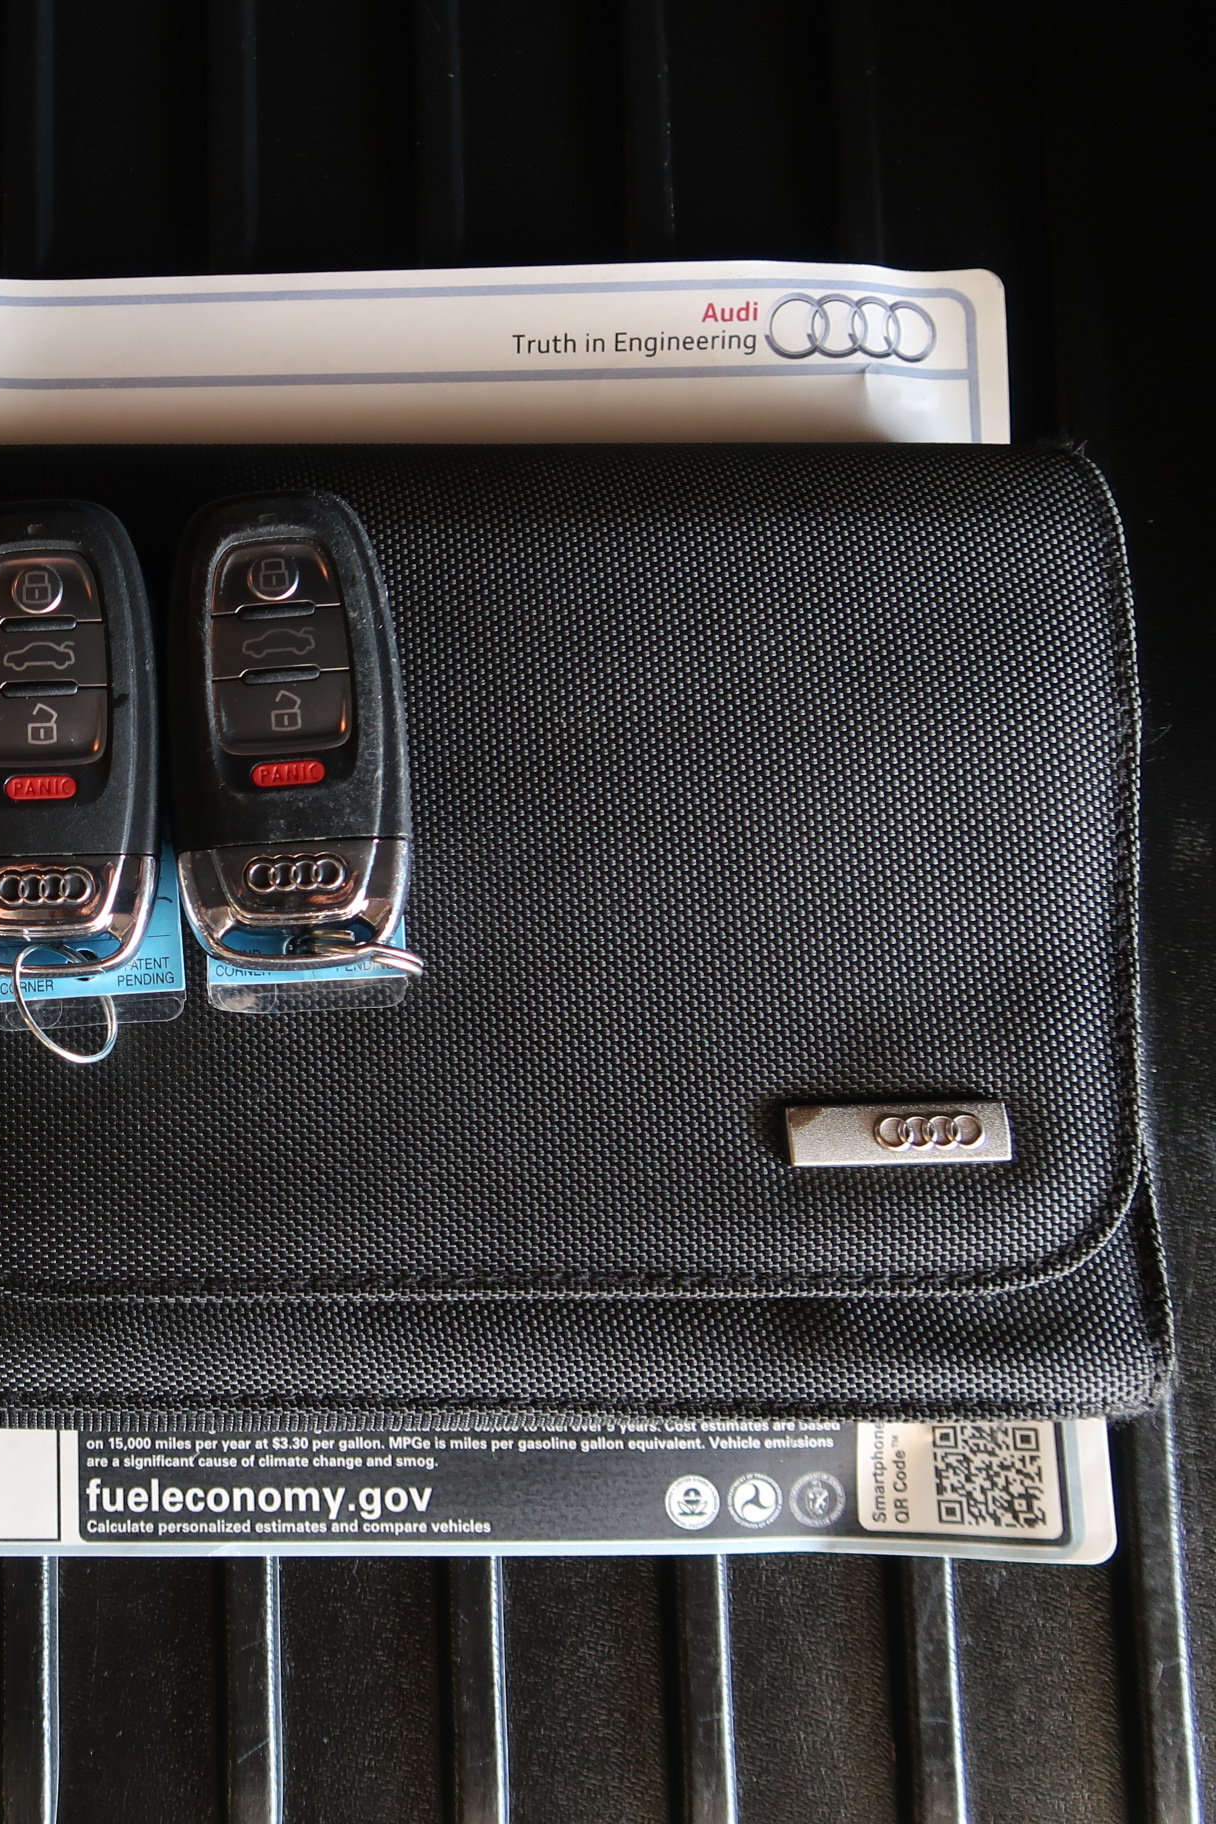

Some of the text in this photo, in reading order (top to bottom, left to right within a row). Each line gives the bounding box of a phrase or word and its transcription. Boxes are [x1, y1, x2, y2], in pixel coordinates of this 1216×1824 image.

[701, 301, 758, 323] Audi
[512, 330, 756, 357] Truth in Engineering
[259, 763, 319, 783] PANIC
[12, 779, 71, 796] PANIC
[124, 957, 170, 971] ATENT
[117, 972, 175, 987] PENDING
[86, 1435, 834, 1454] on 15,000 miles per year at $3.30 per gallon. MPGe is miles per gasoline gallon equivalent. Vehicle emissions
[86, 1457, 108, 1467] are
[124, 1454, 194, 1470] significant
[198, 1457, 237, 1468] cause
[241, 1454, 255, 1467] of
[258, 1454, 309, 1467] climate
[312, 1454, 363, 1470] change
[366, 1454, 392, 1467] and
[396, 1457, 438, 1470] smog.
[871, 1421, 887, 1522] Smartphone
[86, 1477, 432, 1519] fueleconomy.gov
[894, 1498, 910, 1524] QR
[87, 1520, 491, 1536] Calculate personalized estimates and compare vehicles
